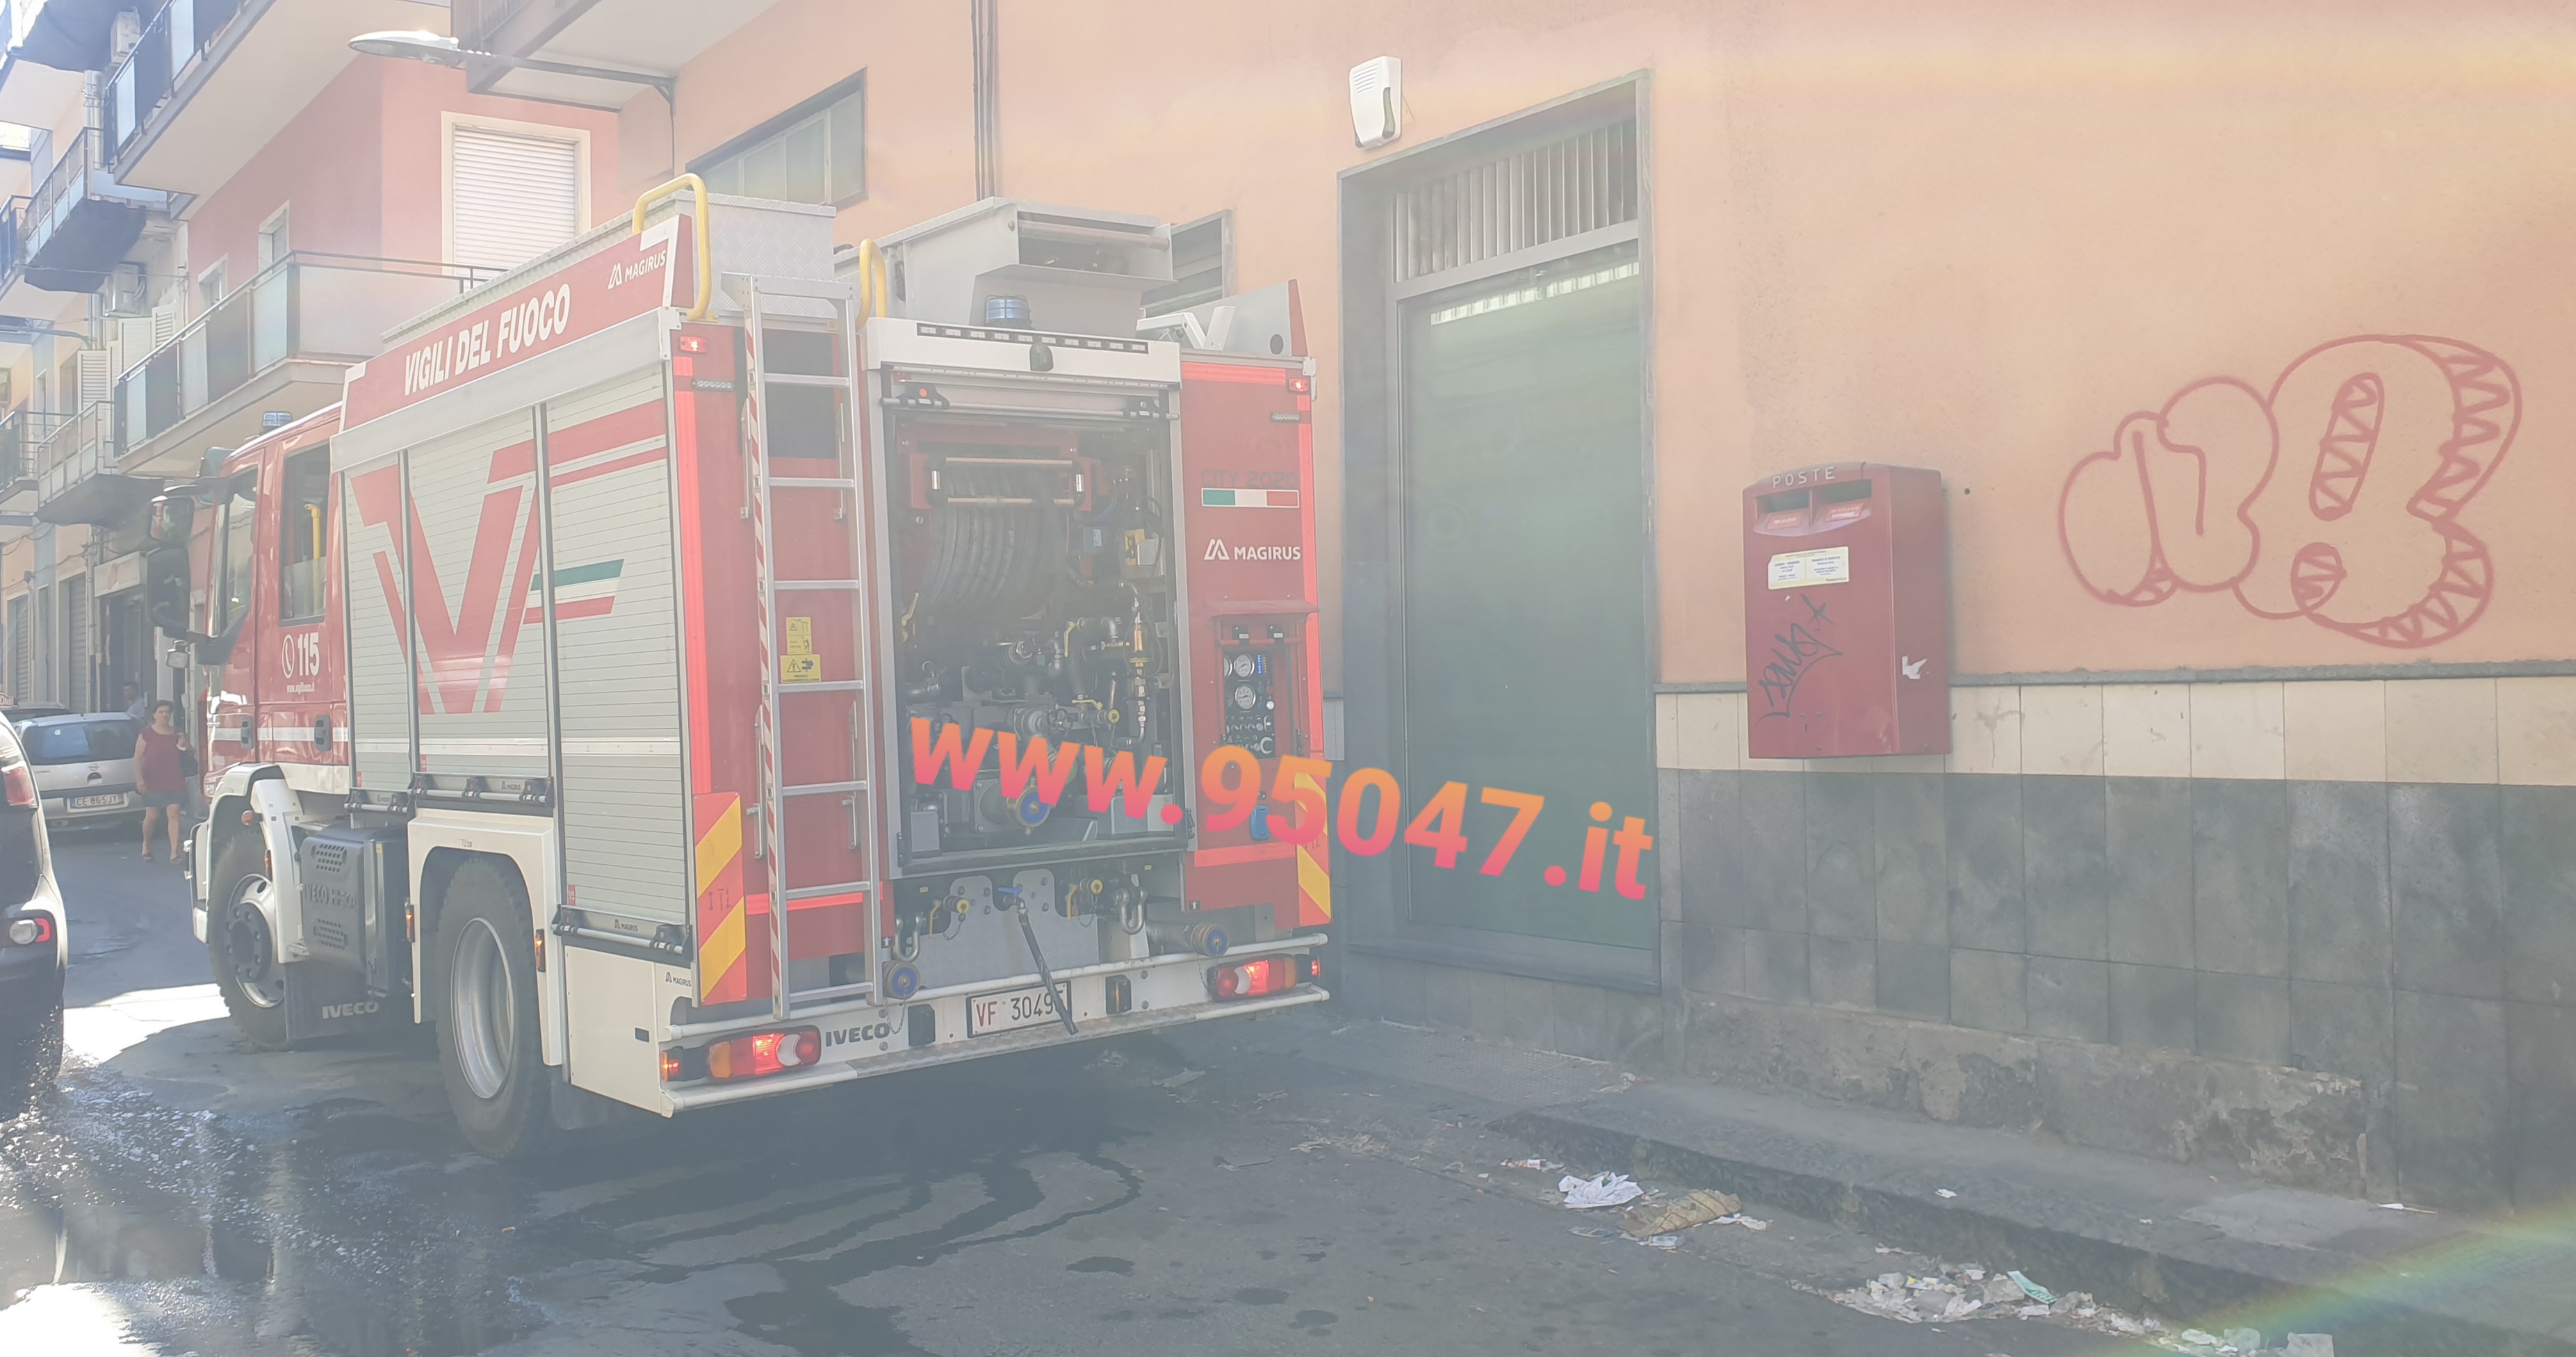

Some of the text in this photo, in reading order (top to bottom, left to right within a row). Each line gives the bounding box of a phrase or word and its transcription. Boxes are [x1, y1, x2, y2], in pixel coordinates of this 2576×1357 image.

[625, 250, 667, 282] MAGIRUS
[405, 283, 571, 396] VIGILI DEL FUOCO
[1200, 469, 1299, 489] CITY 2020
[1772, 466, 1835, 488] POSTE
[1234, 546, 1301, 560] MAGIRUS
[297, 631, 320, 676] 115
[621, 923, 638, 932] MAGIRUS
[673, 977, 692, 987] MAGIRUS
[322, 1001, 380, 1019] IVECO
[976, 1001, 997, 1027] VF
[825, 1023, 890, 1047] IVECO
